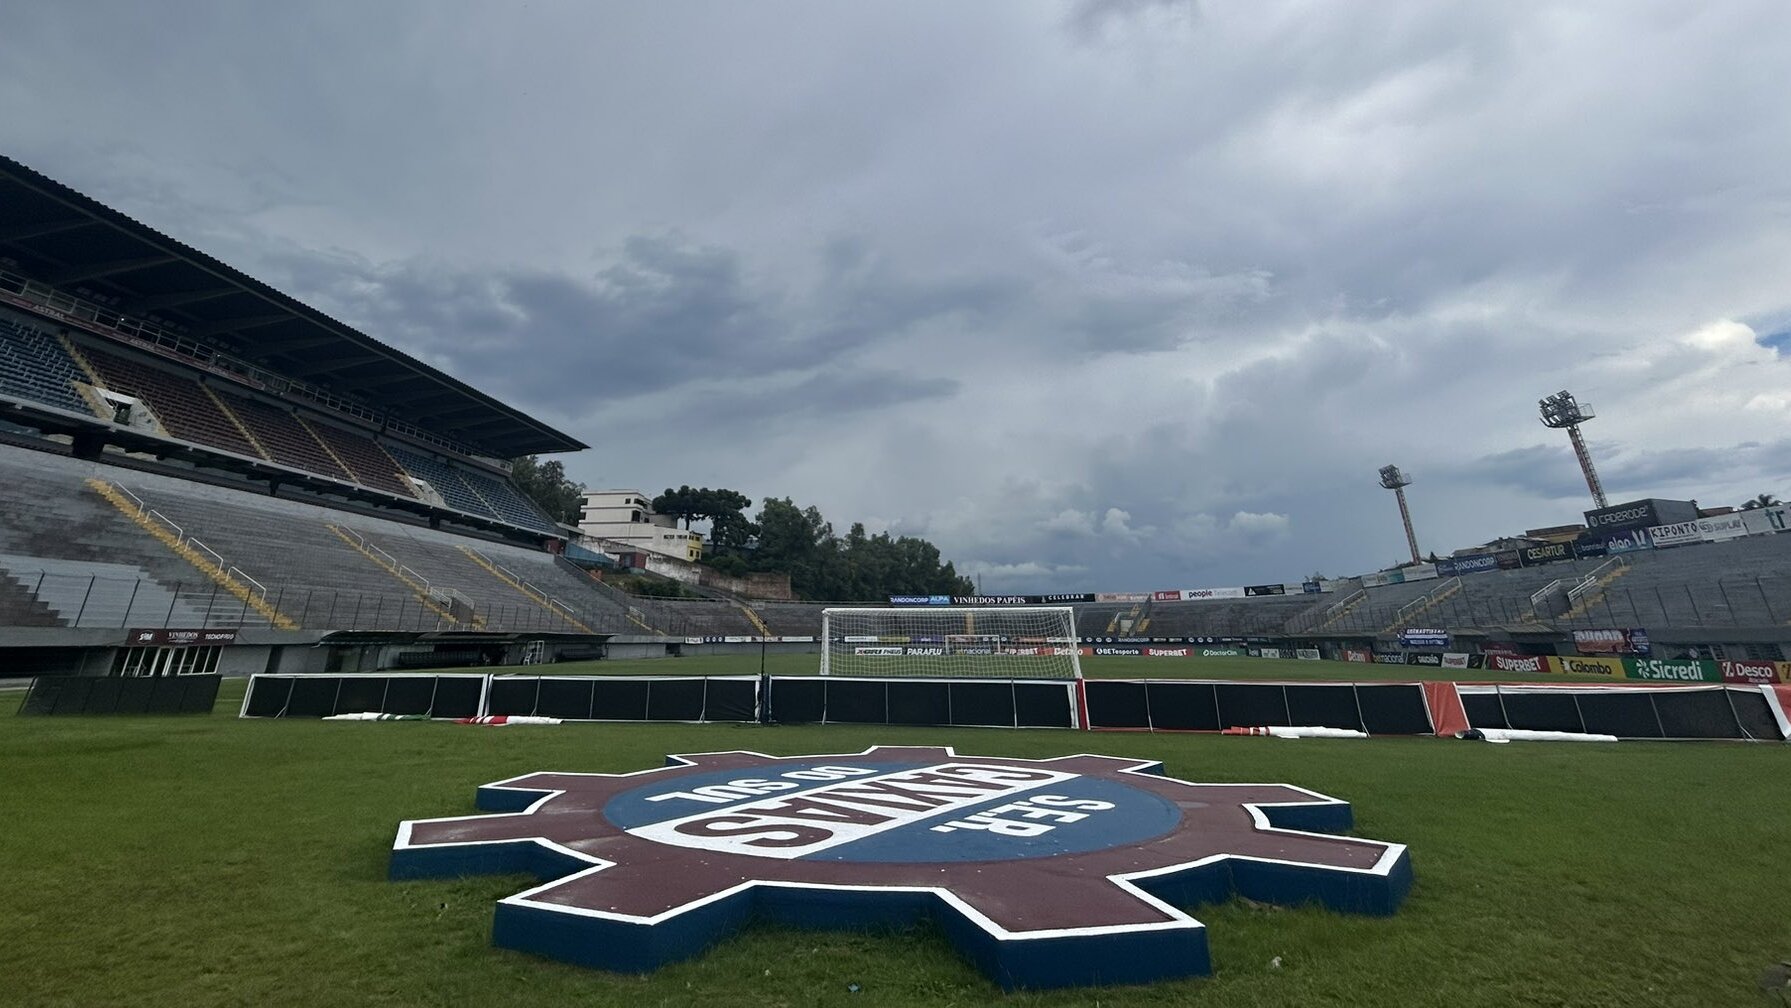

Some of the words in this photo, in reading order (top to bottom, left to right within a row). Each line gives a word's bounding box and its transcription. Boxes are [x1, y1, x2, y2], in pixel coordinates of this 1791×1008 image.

[1651, 523, 1697, 538] KIPONTO
[953, 596, 996, 604] VINHEDOS
[997, 595, 1026, 604] PAPÉIS
[1188, 589, 1213, 599] people
[907, 648, 942, 656] PARAFLU
[1148, 649, 1188, 657] SUPERBET
[1496, 655, 1541, 672] SUPERBET
[1569, 660, 1612, 675] Colombo
[1650, 660, 1704, 681] Sicredi
[1735, 663, 1773, 677] Desco
[780, 765, 879, 781] DO
[644, 778, 800, 804] SUL
[673, 766, 1055, 848] CAXIAS
